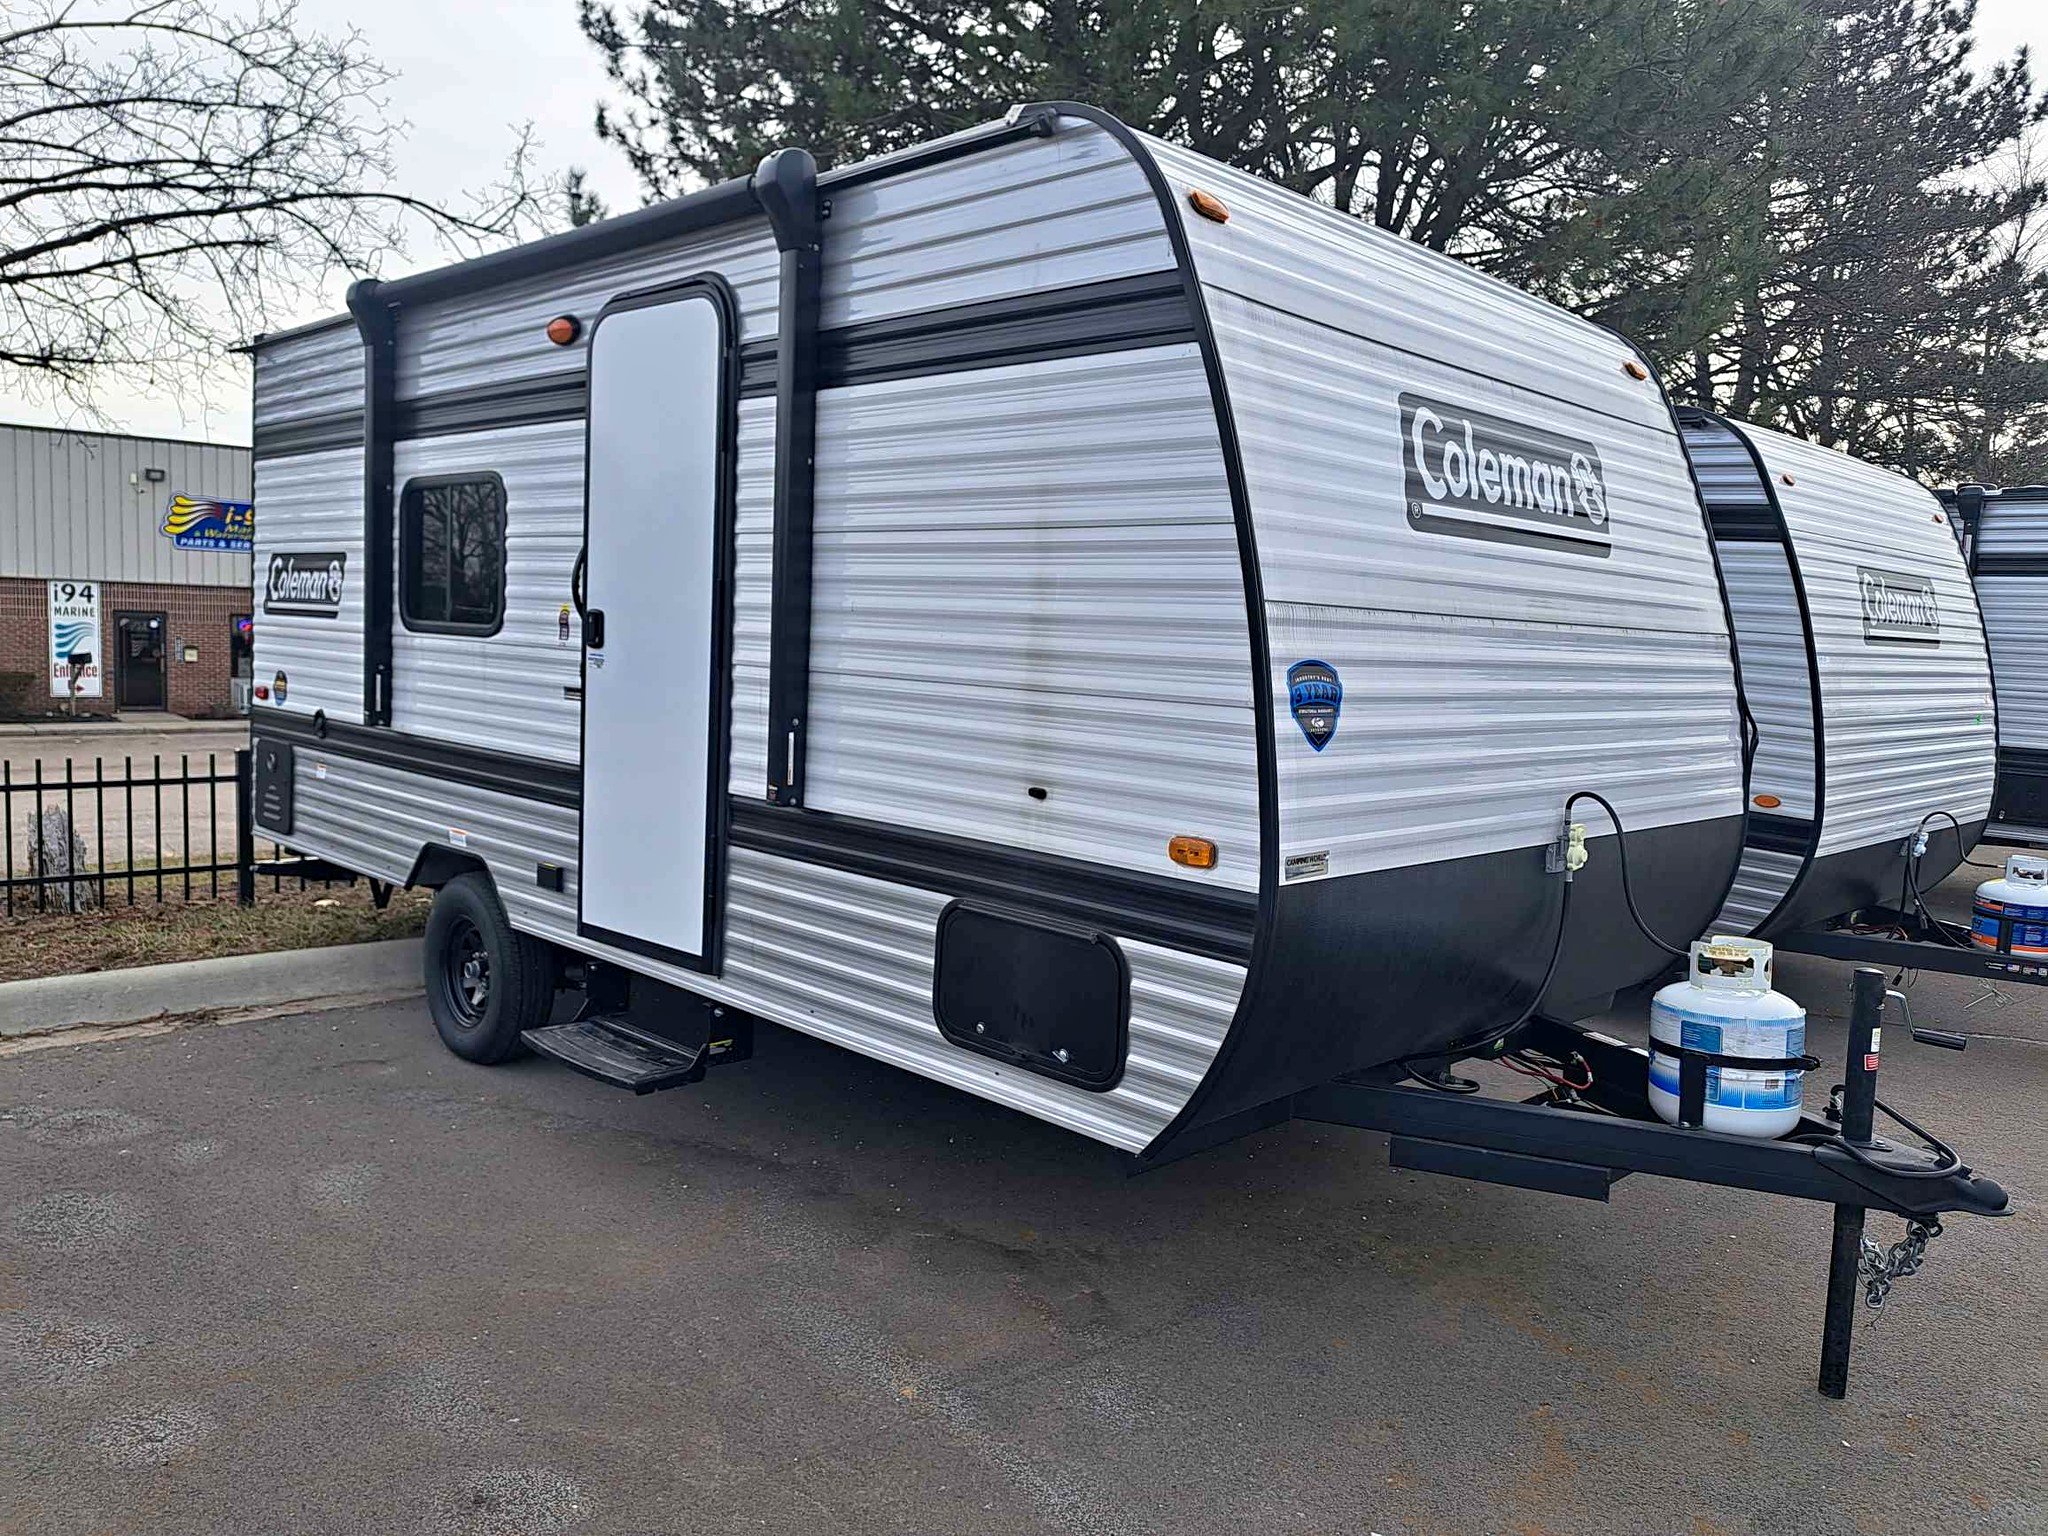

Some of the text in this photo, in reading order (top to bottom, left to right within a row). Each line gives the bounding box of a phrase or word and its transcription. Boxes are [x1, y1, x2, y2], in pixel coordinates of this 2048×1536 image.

[1412, 406, 1574, 517] Coleman
[180, 537, 215, 548] PARTS
[270, 556, 328, 600] Coleman
[54, 583, 95, 603] i94
[1863, 572, 1925, 626] Coleman
[54, 606, 96, 618] MARINE
[1304, 683, 1338, 702] YEAR
